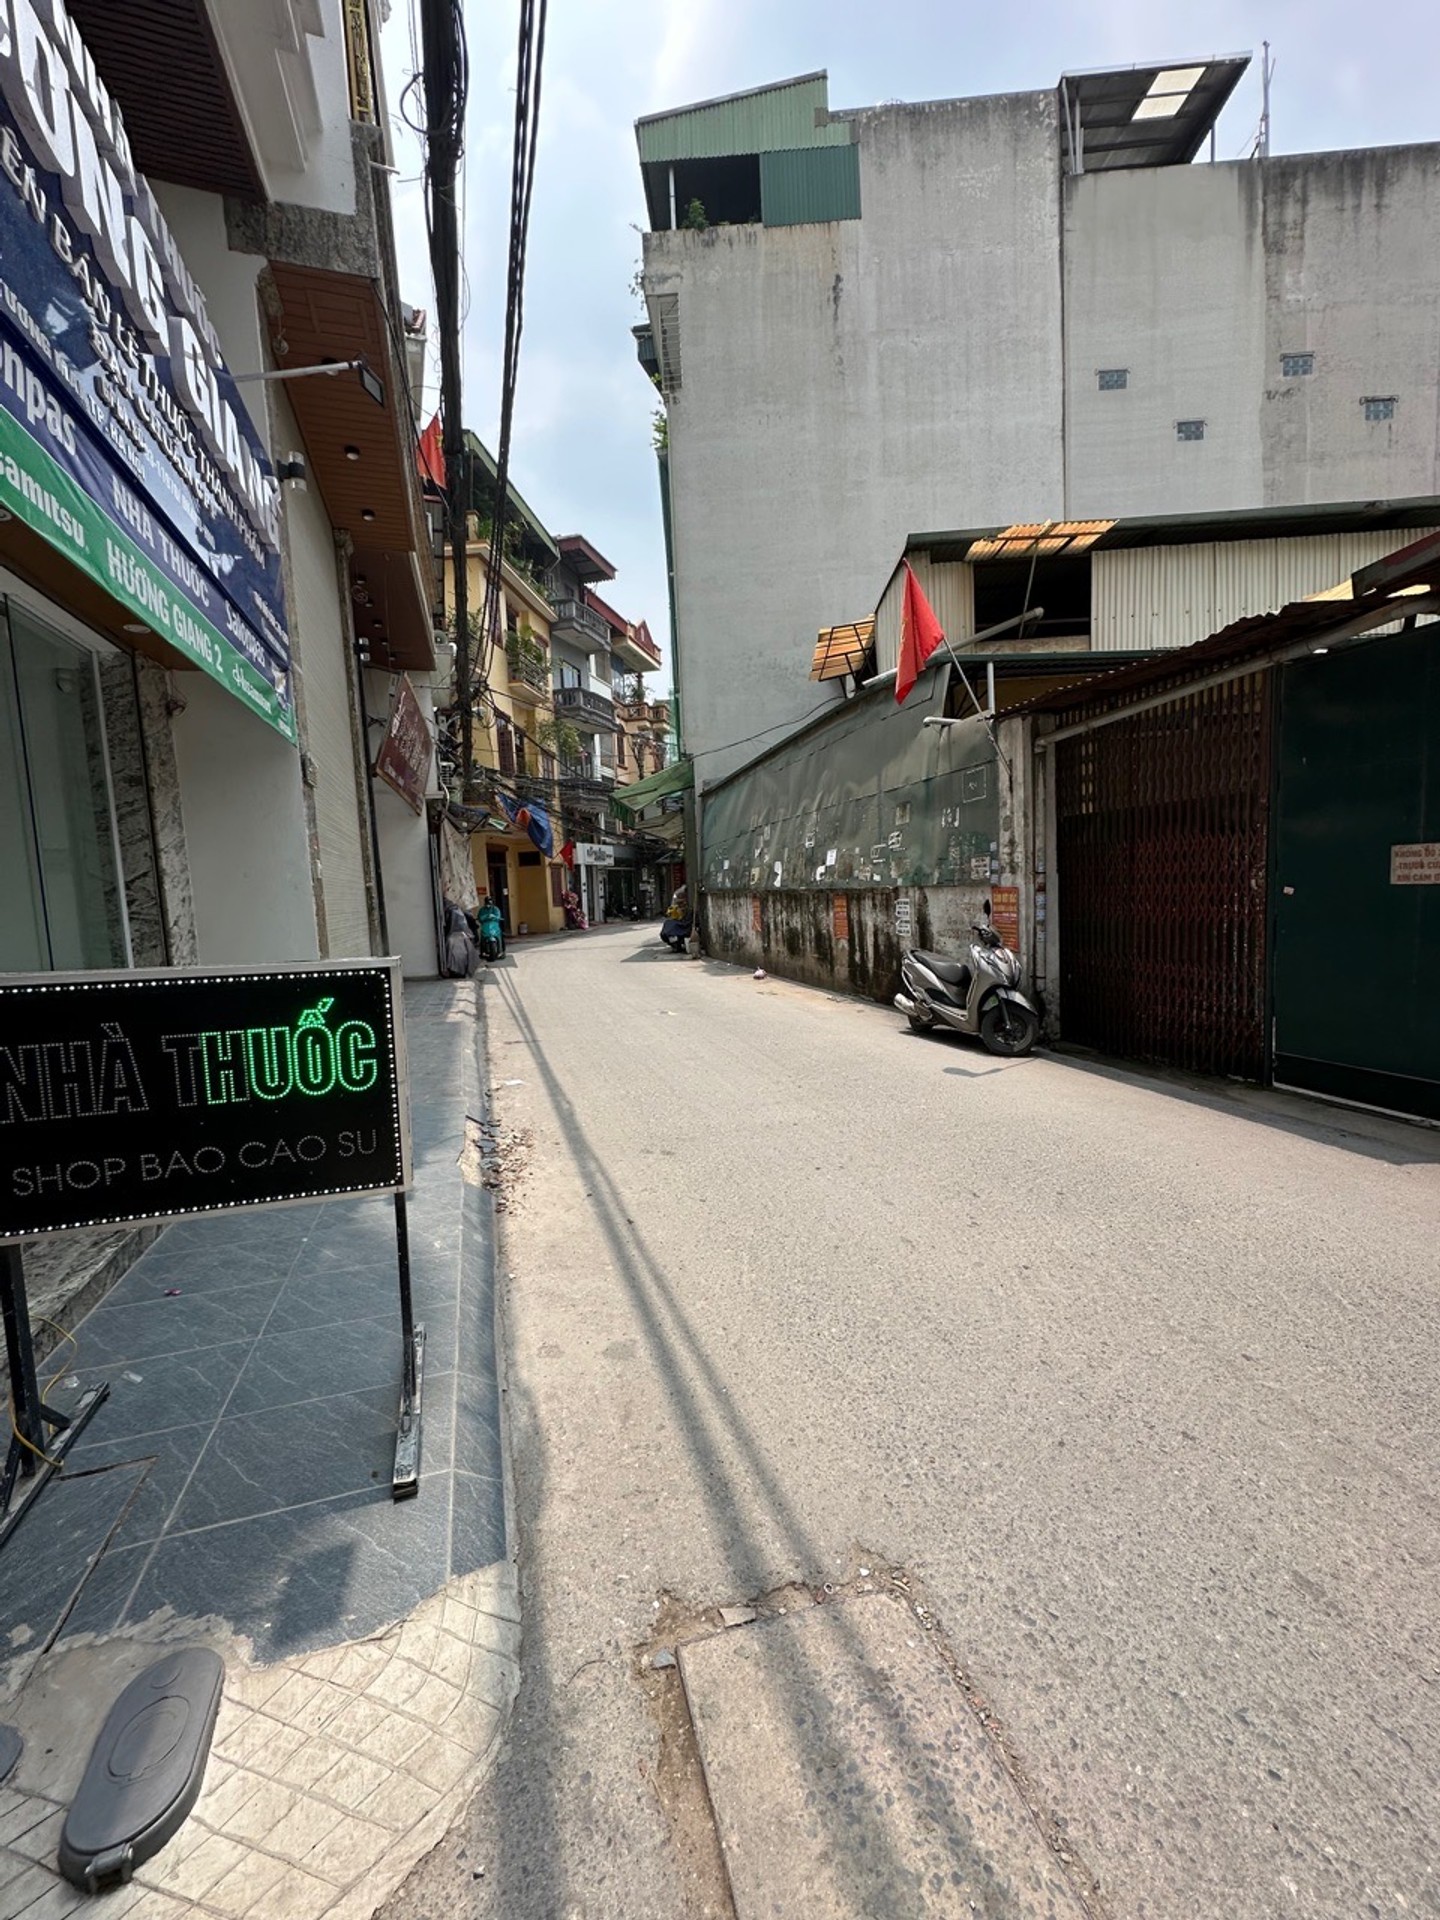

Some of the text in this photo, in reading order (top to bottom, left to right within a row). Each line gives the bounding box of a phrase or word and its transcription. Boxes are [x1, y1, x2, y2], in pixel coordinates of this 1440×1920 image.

[0, 0, 170, 357] ƠNG
[173, 603, 213, 663] GIANG
[214, 643, 223, 673] 2
[0, 997, 378, 1124] NHÀ THUỐC
[12, 1129, 378, 1196] SHOP BAO CAO SU
